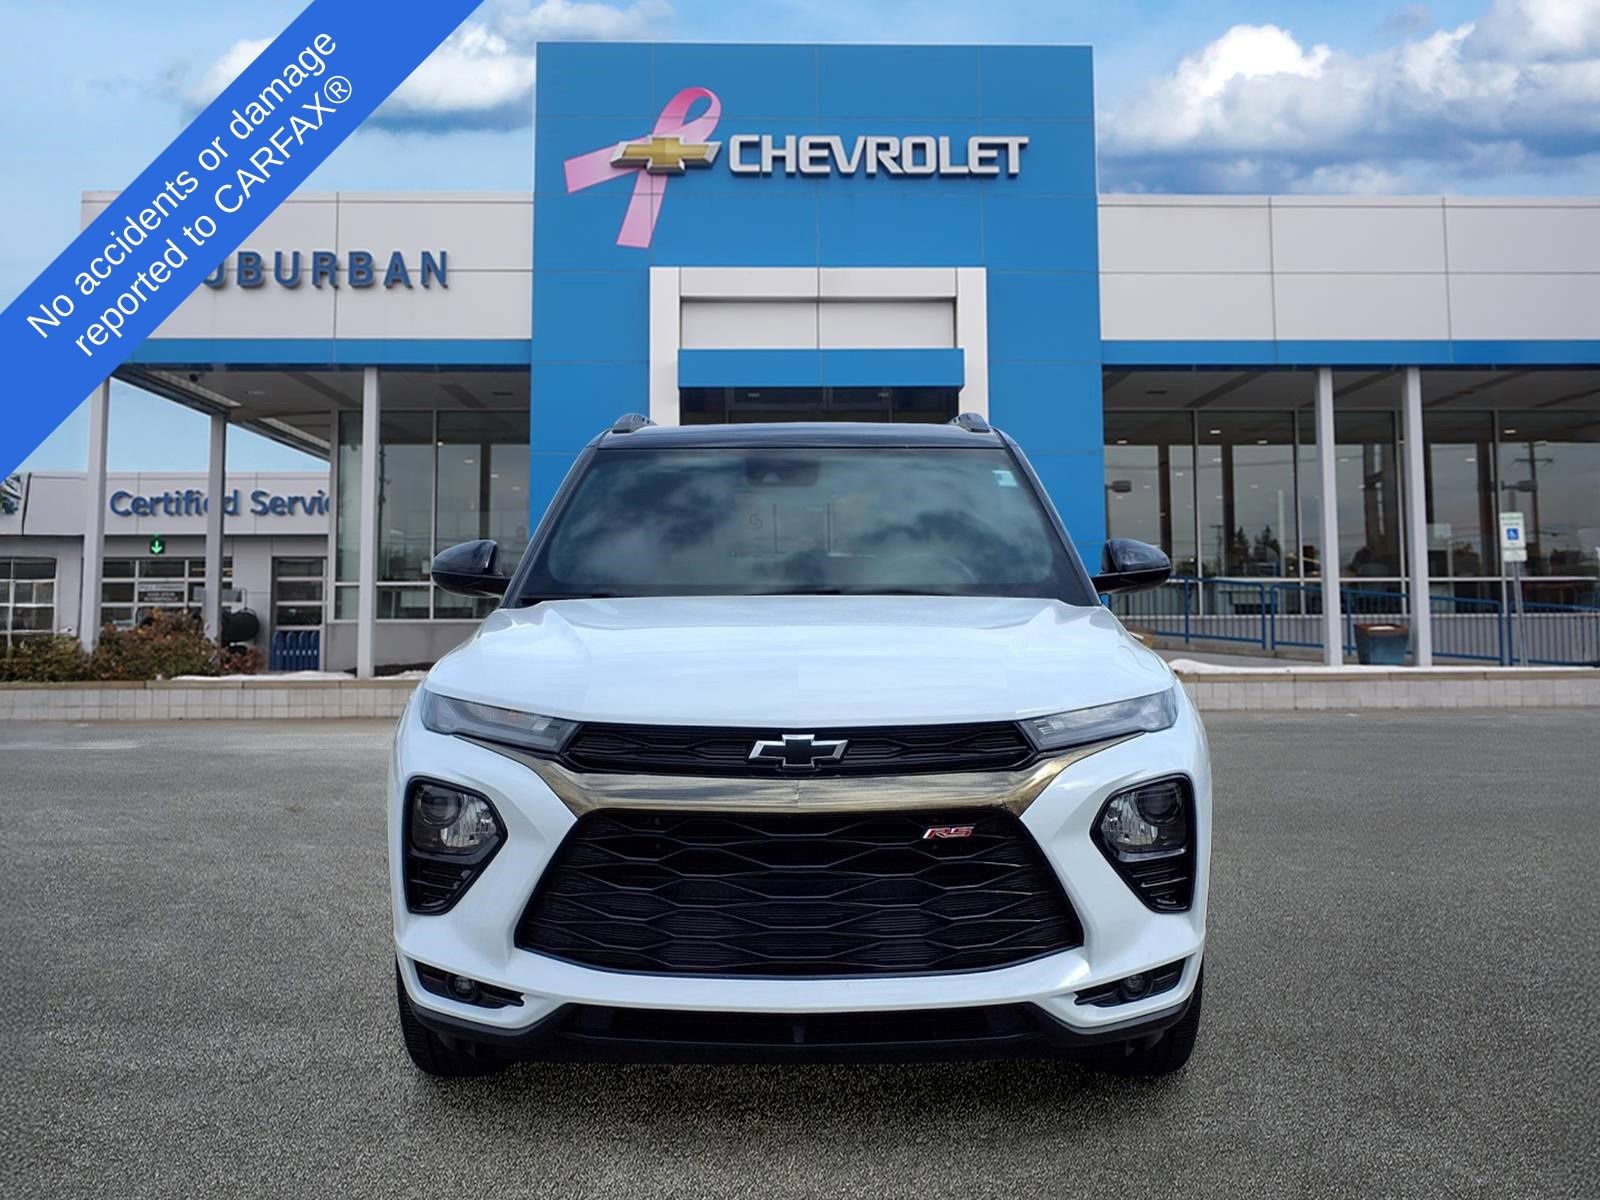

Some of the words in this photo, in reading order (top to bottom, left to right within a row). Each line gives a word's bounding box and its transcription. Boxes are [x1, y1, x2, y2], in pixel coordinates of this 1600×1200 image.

[729, 134, 1029, 175] CHEVROLET
[110, 488, 241, 517] Certifid
[922, 825, 974, 839] RS
